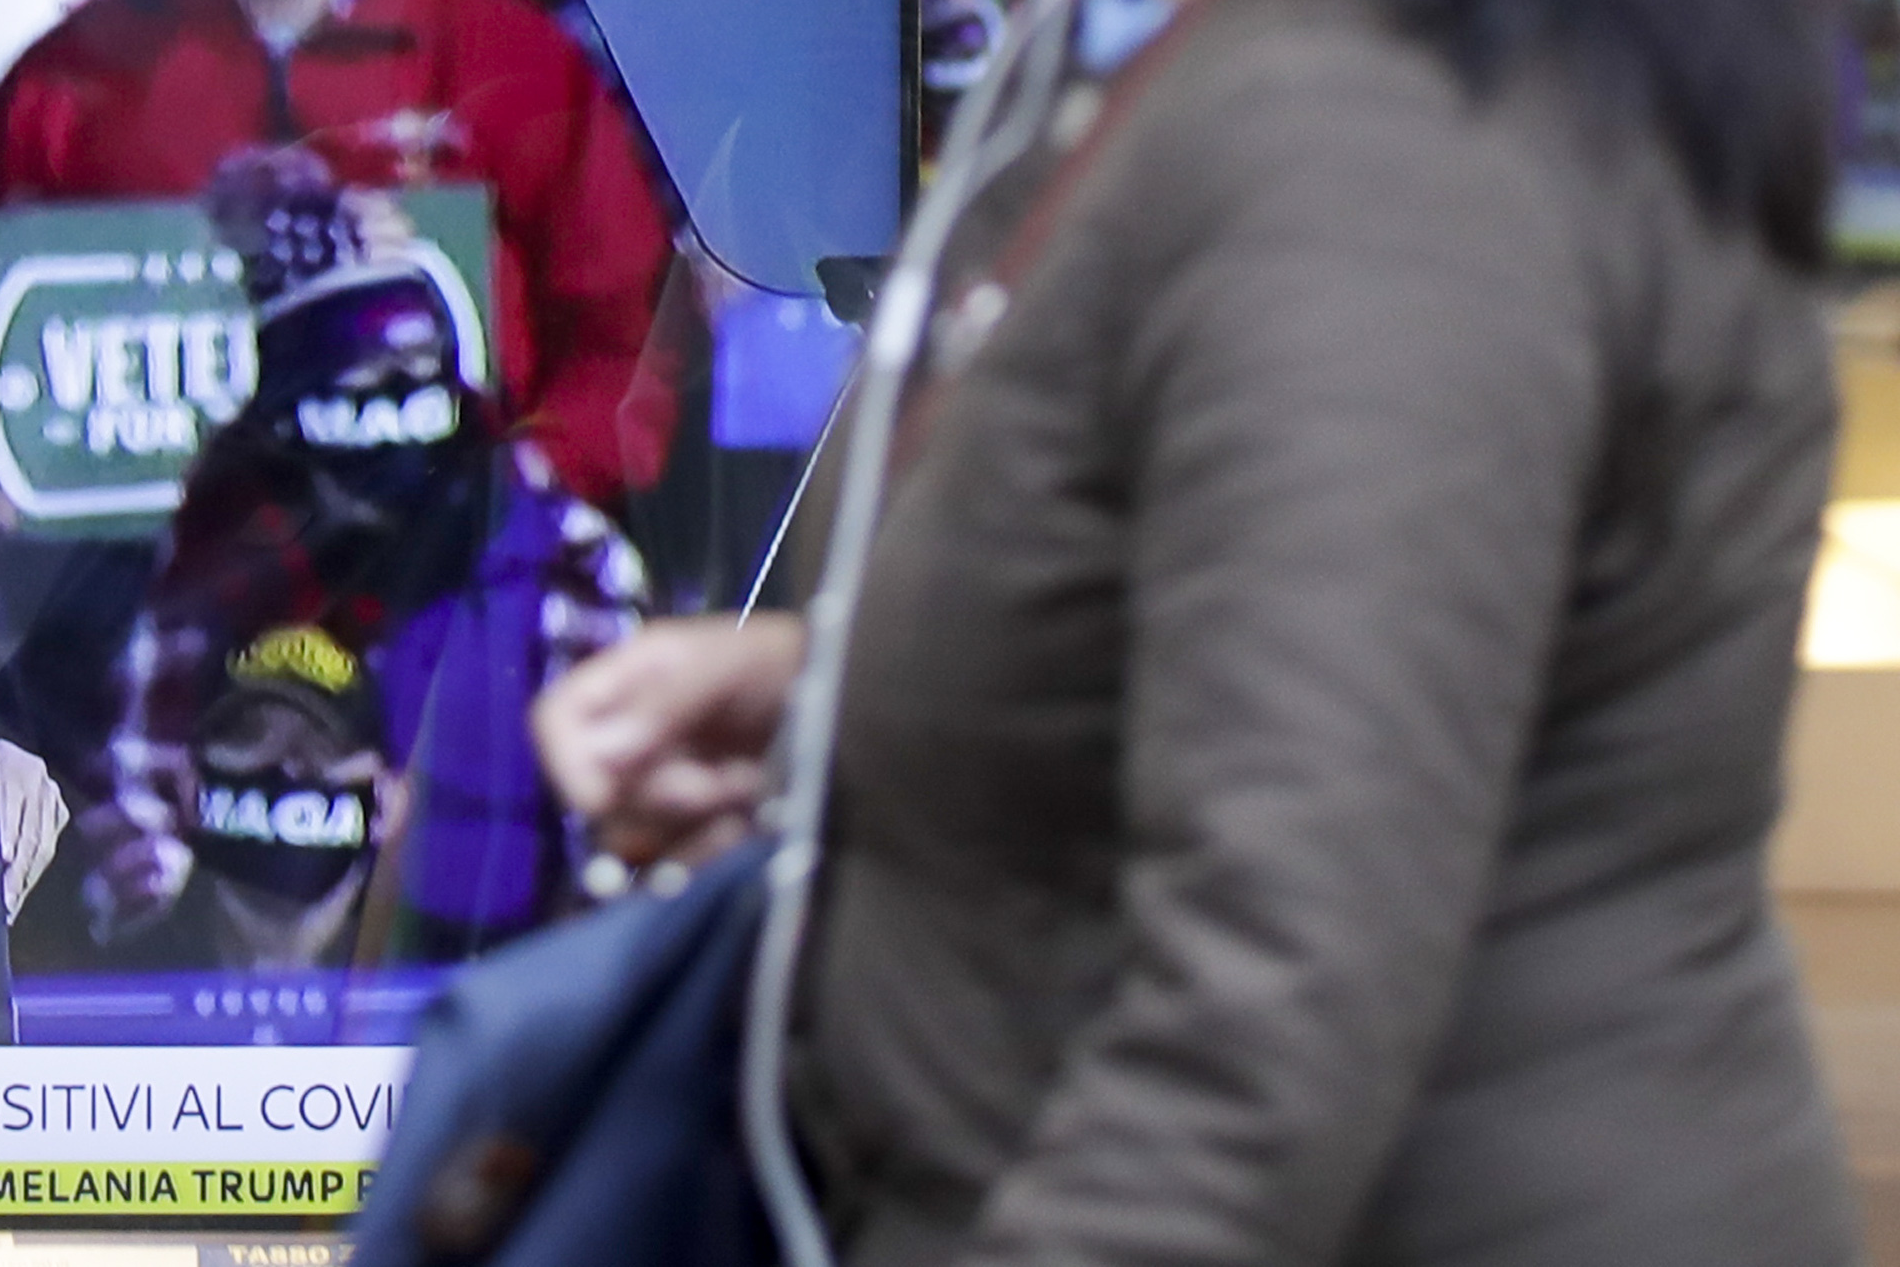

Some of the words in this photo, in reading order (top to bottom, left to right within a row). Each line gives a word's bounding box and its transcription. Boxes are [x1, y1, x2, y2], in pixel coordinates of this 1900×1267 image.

[172, 1084, 244, 1131] AL
[260, 1083, 393, 1132] COVI
[193, 1169, 344, 1203] TRUMP
